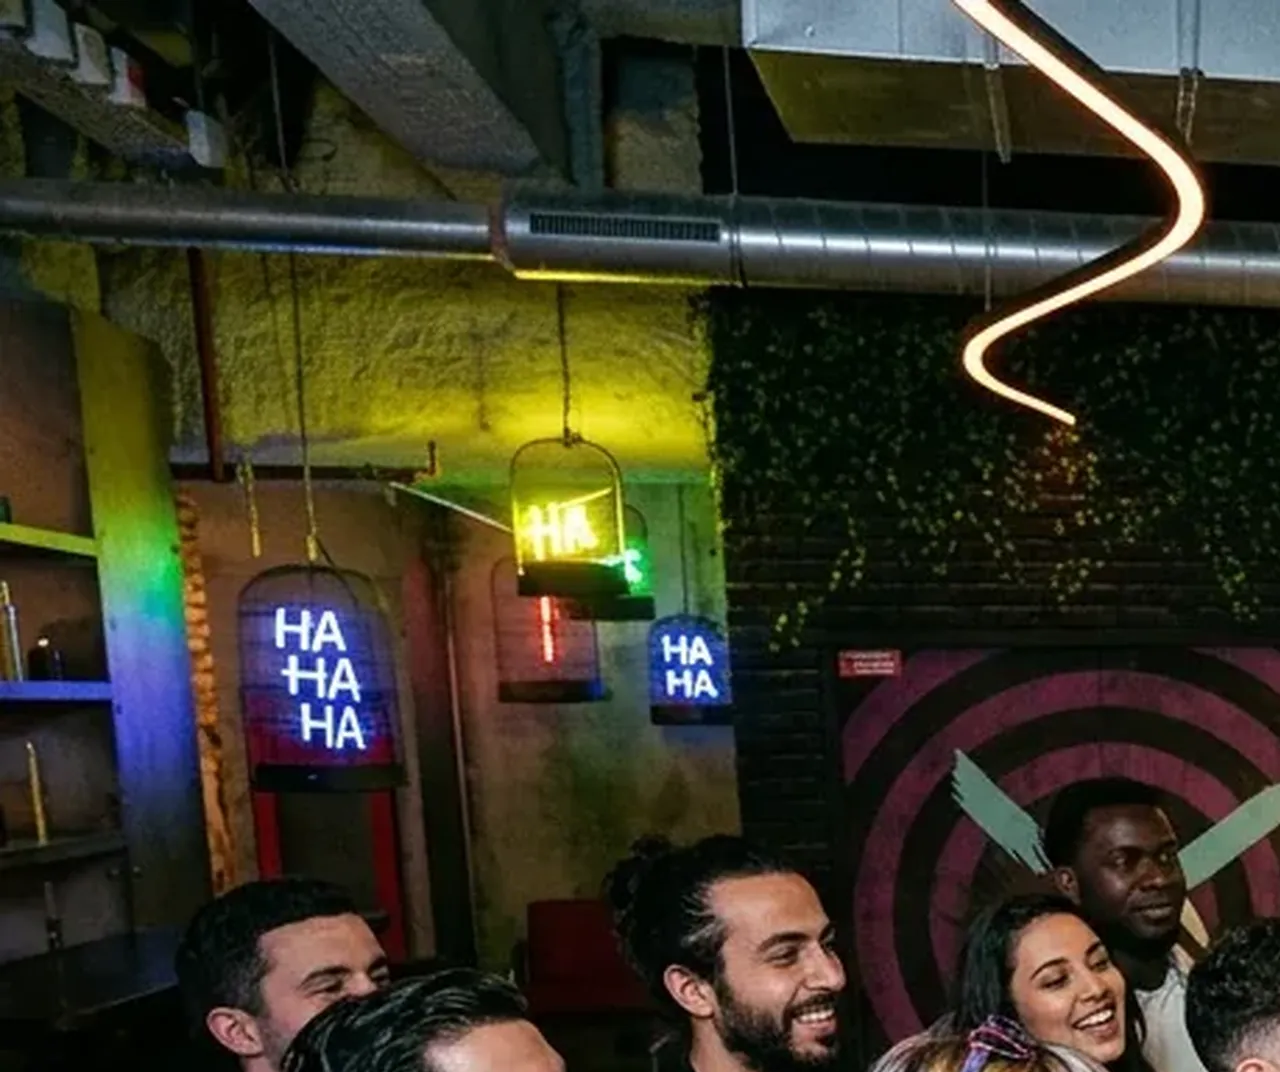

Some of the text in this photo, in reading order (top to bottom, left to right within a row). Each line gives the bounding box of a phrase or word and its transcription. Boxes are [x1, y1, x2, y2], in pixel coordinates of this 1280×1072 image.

[526, 502, 599, 560] HA
[275, 607, 347, 652] HA
[661, 634, 714, 666] HA
[280, 655, 361, 703] HA
[665, 669, 719, 698] HA
[300, 702, 367, 750] HA
